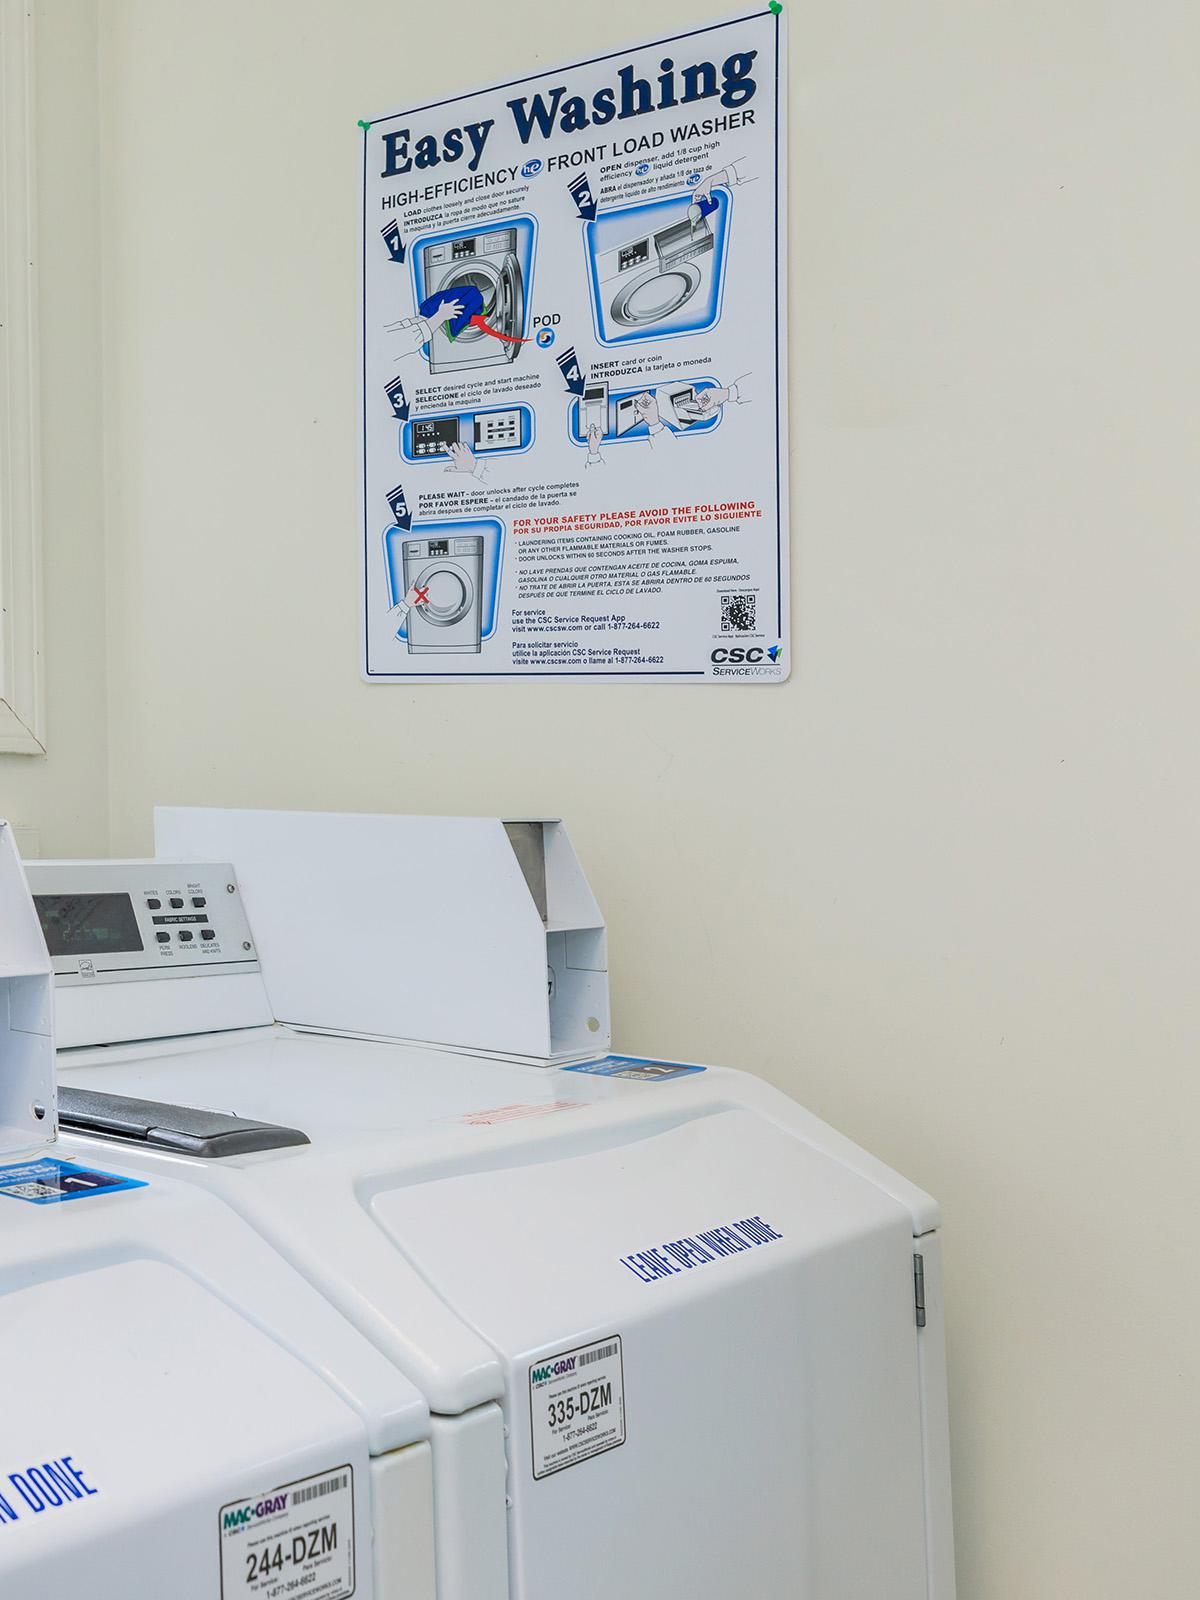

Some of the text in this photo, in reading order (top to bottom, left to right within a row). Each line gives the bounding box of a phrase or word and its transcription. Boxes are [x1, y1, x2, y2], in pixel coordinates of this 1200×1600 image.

[380, 50, 758, 179] Easy Washing
[381, 109, 756, 210] HIGH-EFFICIENCY FRONT LOAD WASHER
[600, 138, 720, 174] OPEN dispenser, add 1/8 cup high
[674, 151, 709, 166] detergent
[578, 191, 590, 207] 2
[390, 236, 400, 250] 1
[533, 313, 561, 328] POD
[590, 360, 619, 370] INSERT
[621, 358, 636, 366] card
[647, 355, 663, 363] coin
[590, 366, 643, 379] INTRODUZCA
[653, 362, 675, 371] tarjeta
[683, 357, 711, 366] moneda
[566, 365, 580, 381] 4
[415, 386, 442, 395] SELECT
[443, 383, 466, 392] desired
[467, 381, 483, 389] cycle
[512, 374, 540, 382] machine
[415, 392, 459, 403] SELECCIONE
[467, 389, 482, 397] ciclo
[493, 385, 513, 394] lavado
[514, 382, 541, 391] deseado
[393, 393, 404, 408] 3
[419, 493, 445, 501] PLEASE
[486, 487, 511, 495] unlocks
[528, 484, 545, 493] cycle
[546, 482, 580, 491] completes
[419, 501, 433, 509] POR
[435, 499, 460, 507] FAVOR
[461, 497, 488, 505] ESPERE
[502, 494, 529, 502] candado
[547, 491, 567, 500] puerta
[395, 502, 407, 517] 5
[513, 501, 755, 527] FOR YOUR SAFETY PLEASE AVOID THE FOLLOWING
[544, 524, 572, 532] PROPIA
[574, 521, 622, 530] SEGURIDAD,
[624, 519, 641, 527] POR
[644, 517, 671, 525] FAVOR
[673, 515, 697, 523] EVITE
[714, 510, 762, 520] SIGUIENTE
[511, 625, 526, 633] visit
[607, 622, 660, 630] 1-877-264-6622
[581, 615, 609, 624] Request
[611, 615, 625, 623] App
[613, 648, 641, 657] Request
[615, 656, 664, 664] 1-877-264-6622
[711, 647, 764, 663] CSC
[619, 1214, 783, 1284] LEAVE OPEN WHEN DONE
[548, 1382, 612, 1427] 335-DZM
[8, 1455, 98, 1513] DONE
[246, 1522, 338, 1583] 244-DZM
